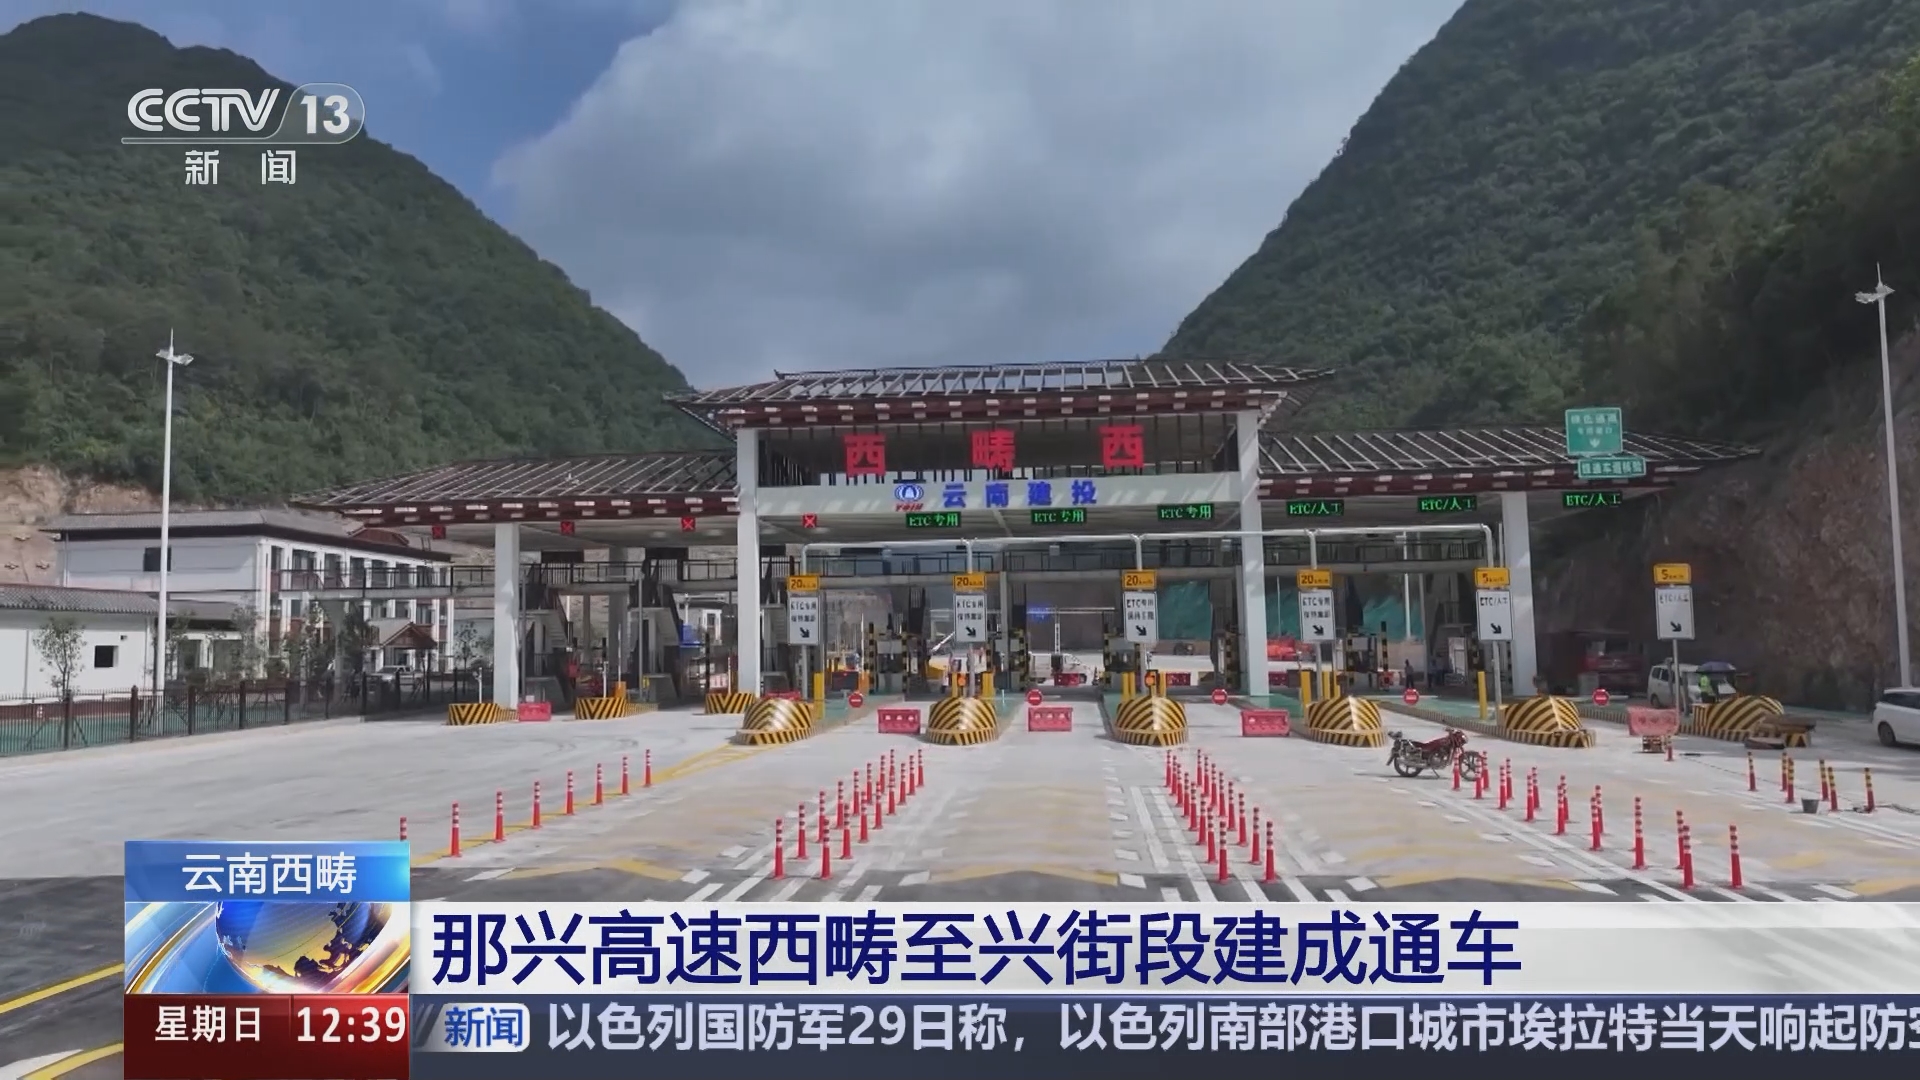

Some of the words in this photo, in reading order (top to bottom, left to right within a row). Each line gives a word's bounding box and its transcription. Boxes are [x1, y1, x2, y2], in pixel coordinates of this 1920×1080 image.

[844, 425, 1145, 477] 西畴西
[942, 480, 1097, 508] 云南建投
